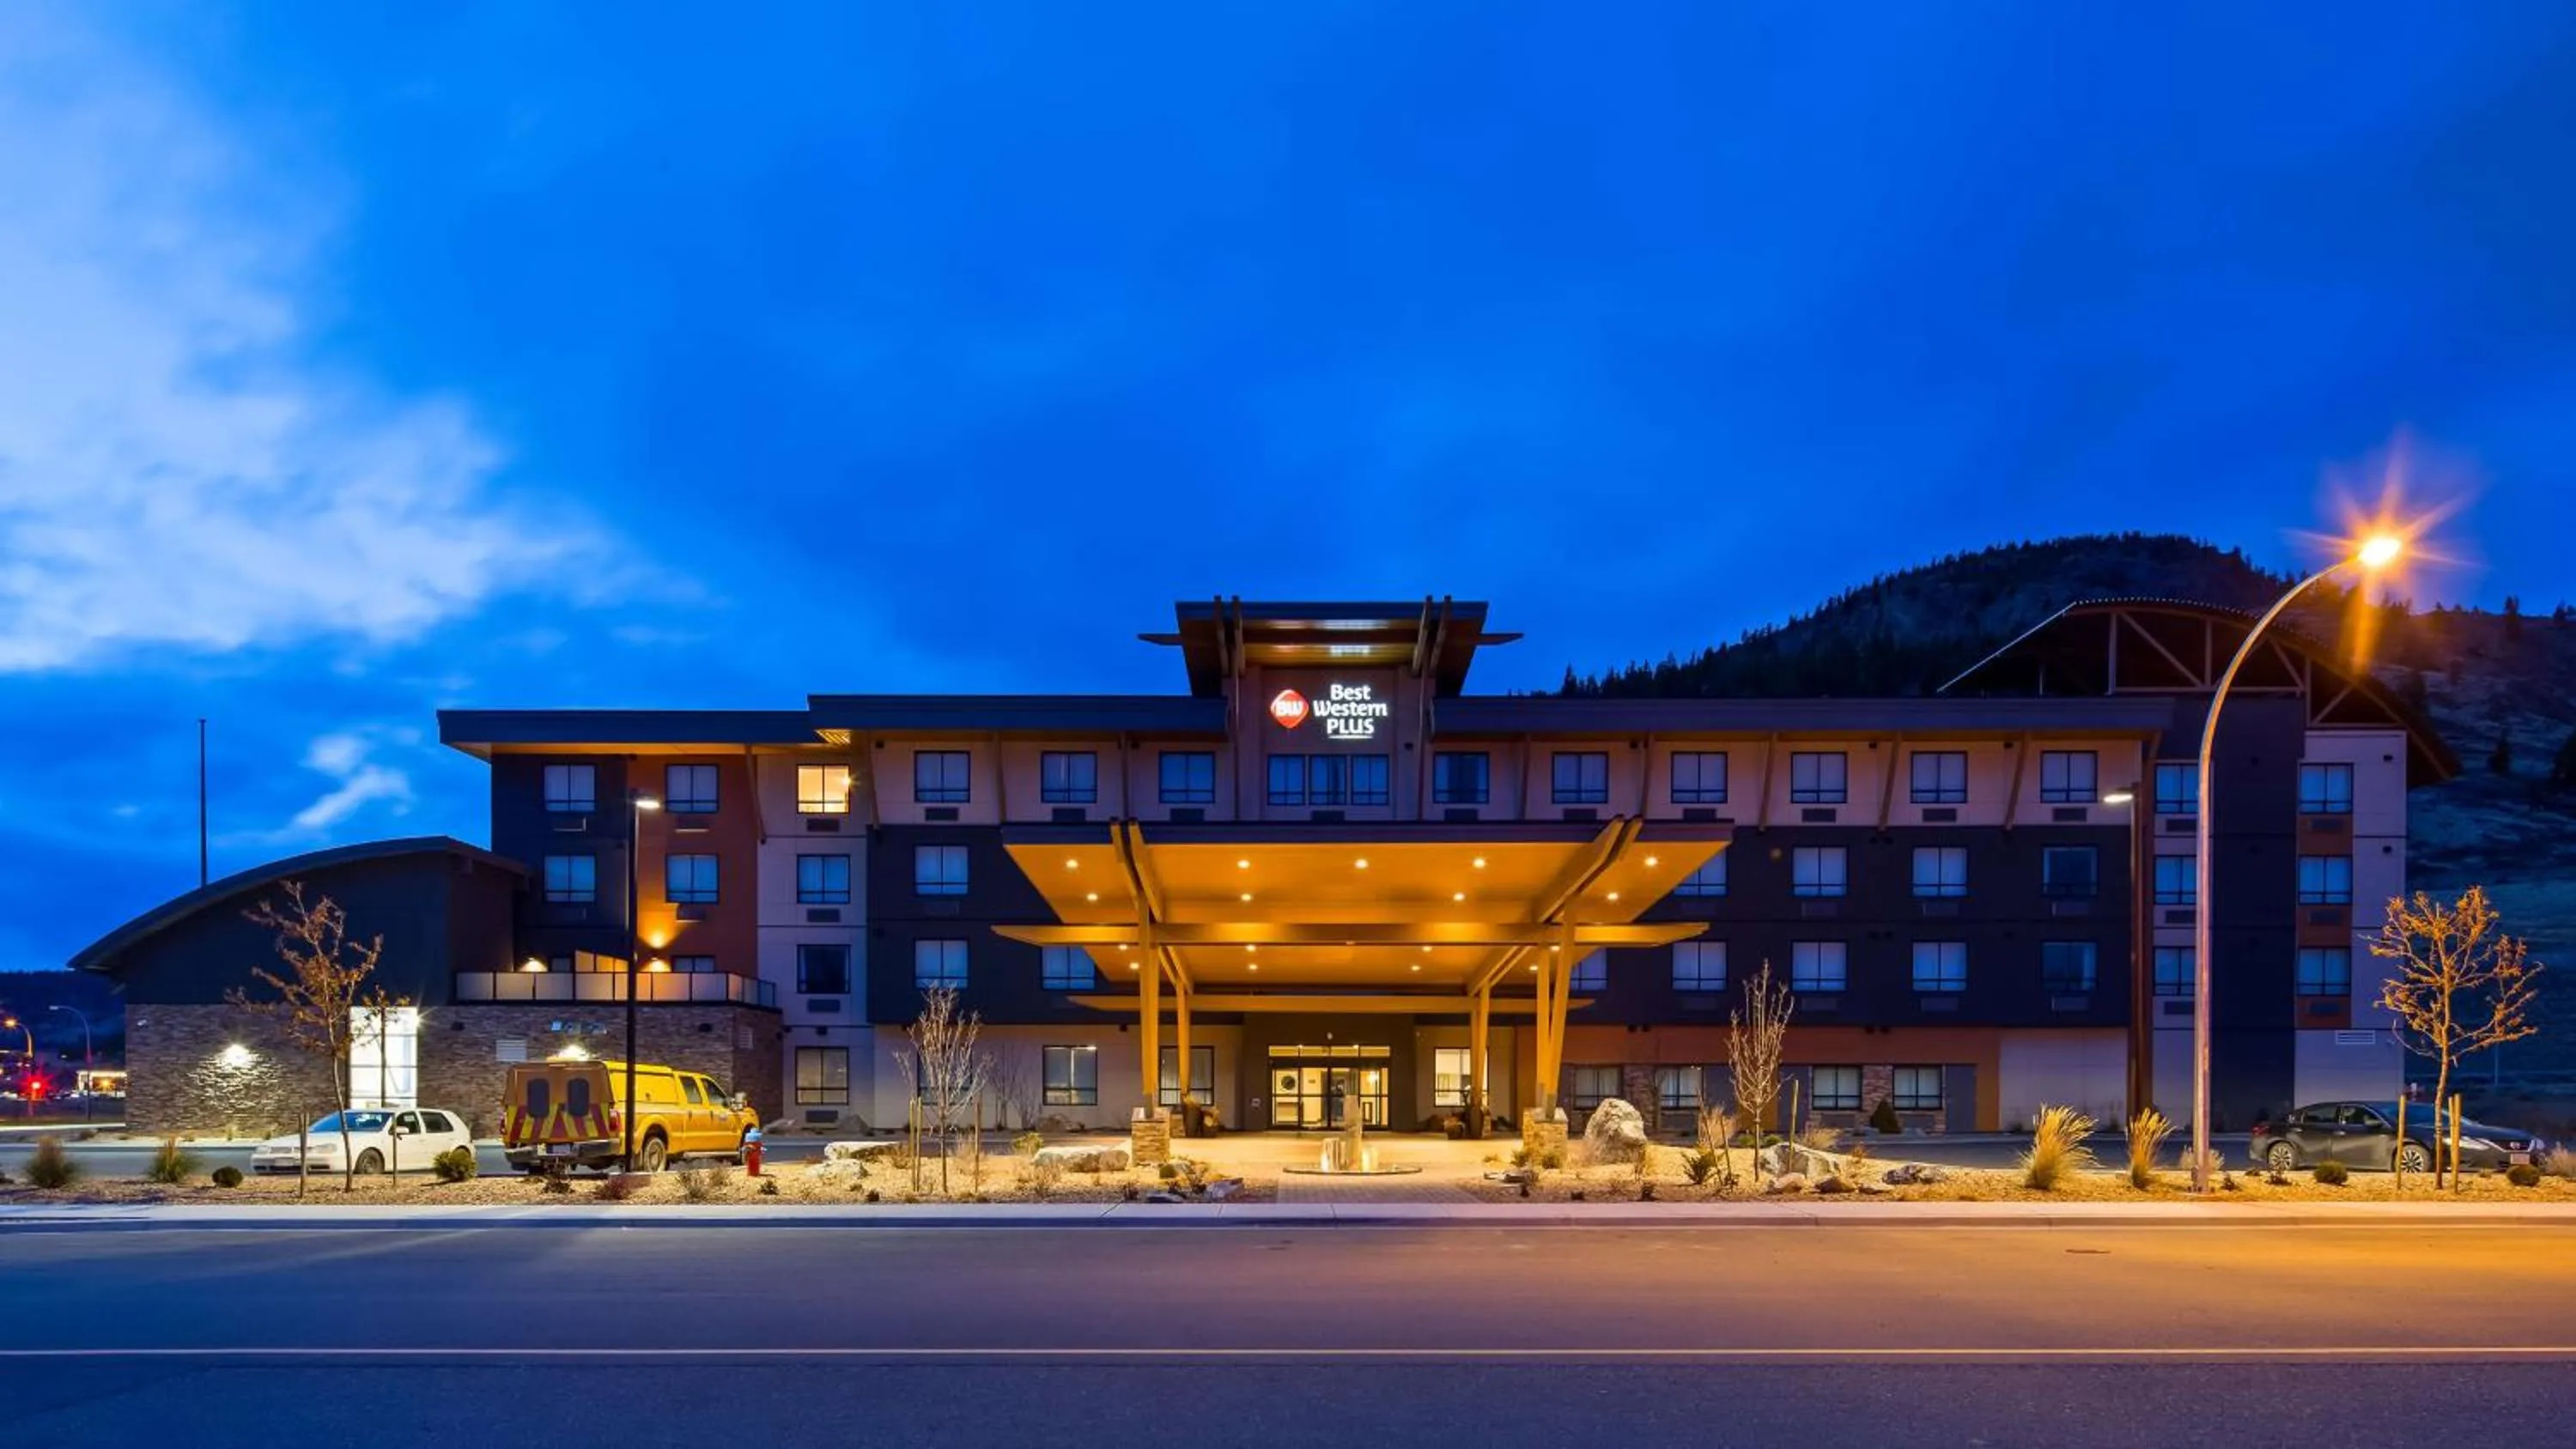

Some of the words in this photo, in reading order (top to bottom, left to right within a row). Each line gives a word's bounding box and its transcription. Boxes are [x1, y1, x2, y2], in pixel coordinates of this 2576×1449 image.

[1330, 684, 1371, 700] Best
[1276, 700, 1303, 717] BW
[1312, 700, 1388, 717] Western
[1327, 718, 1374, 734] PLUS
